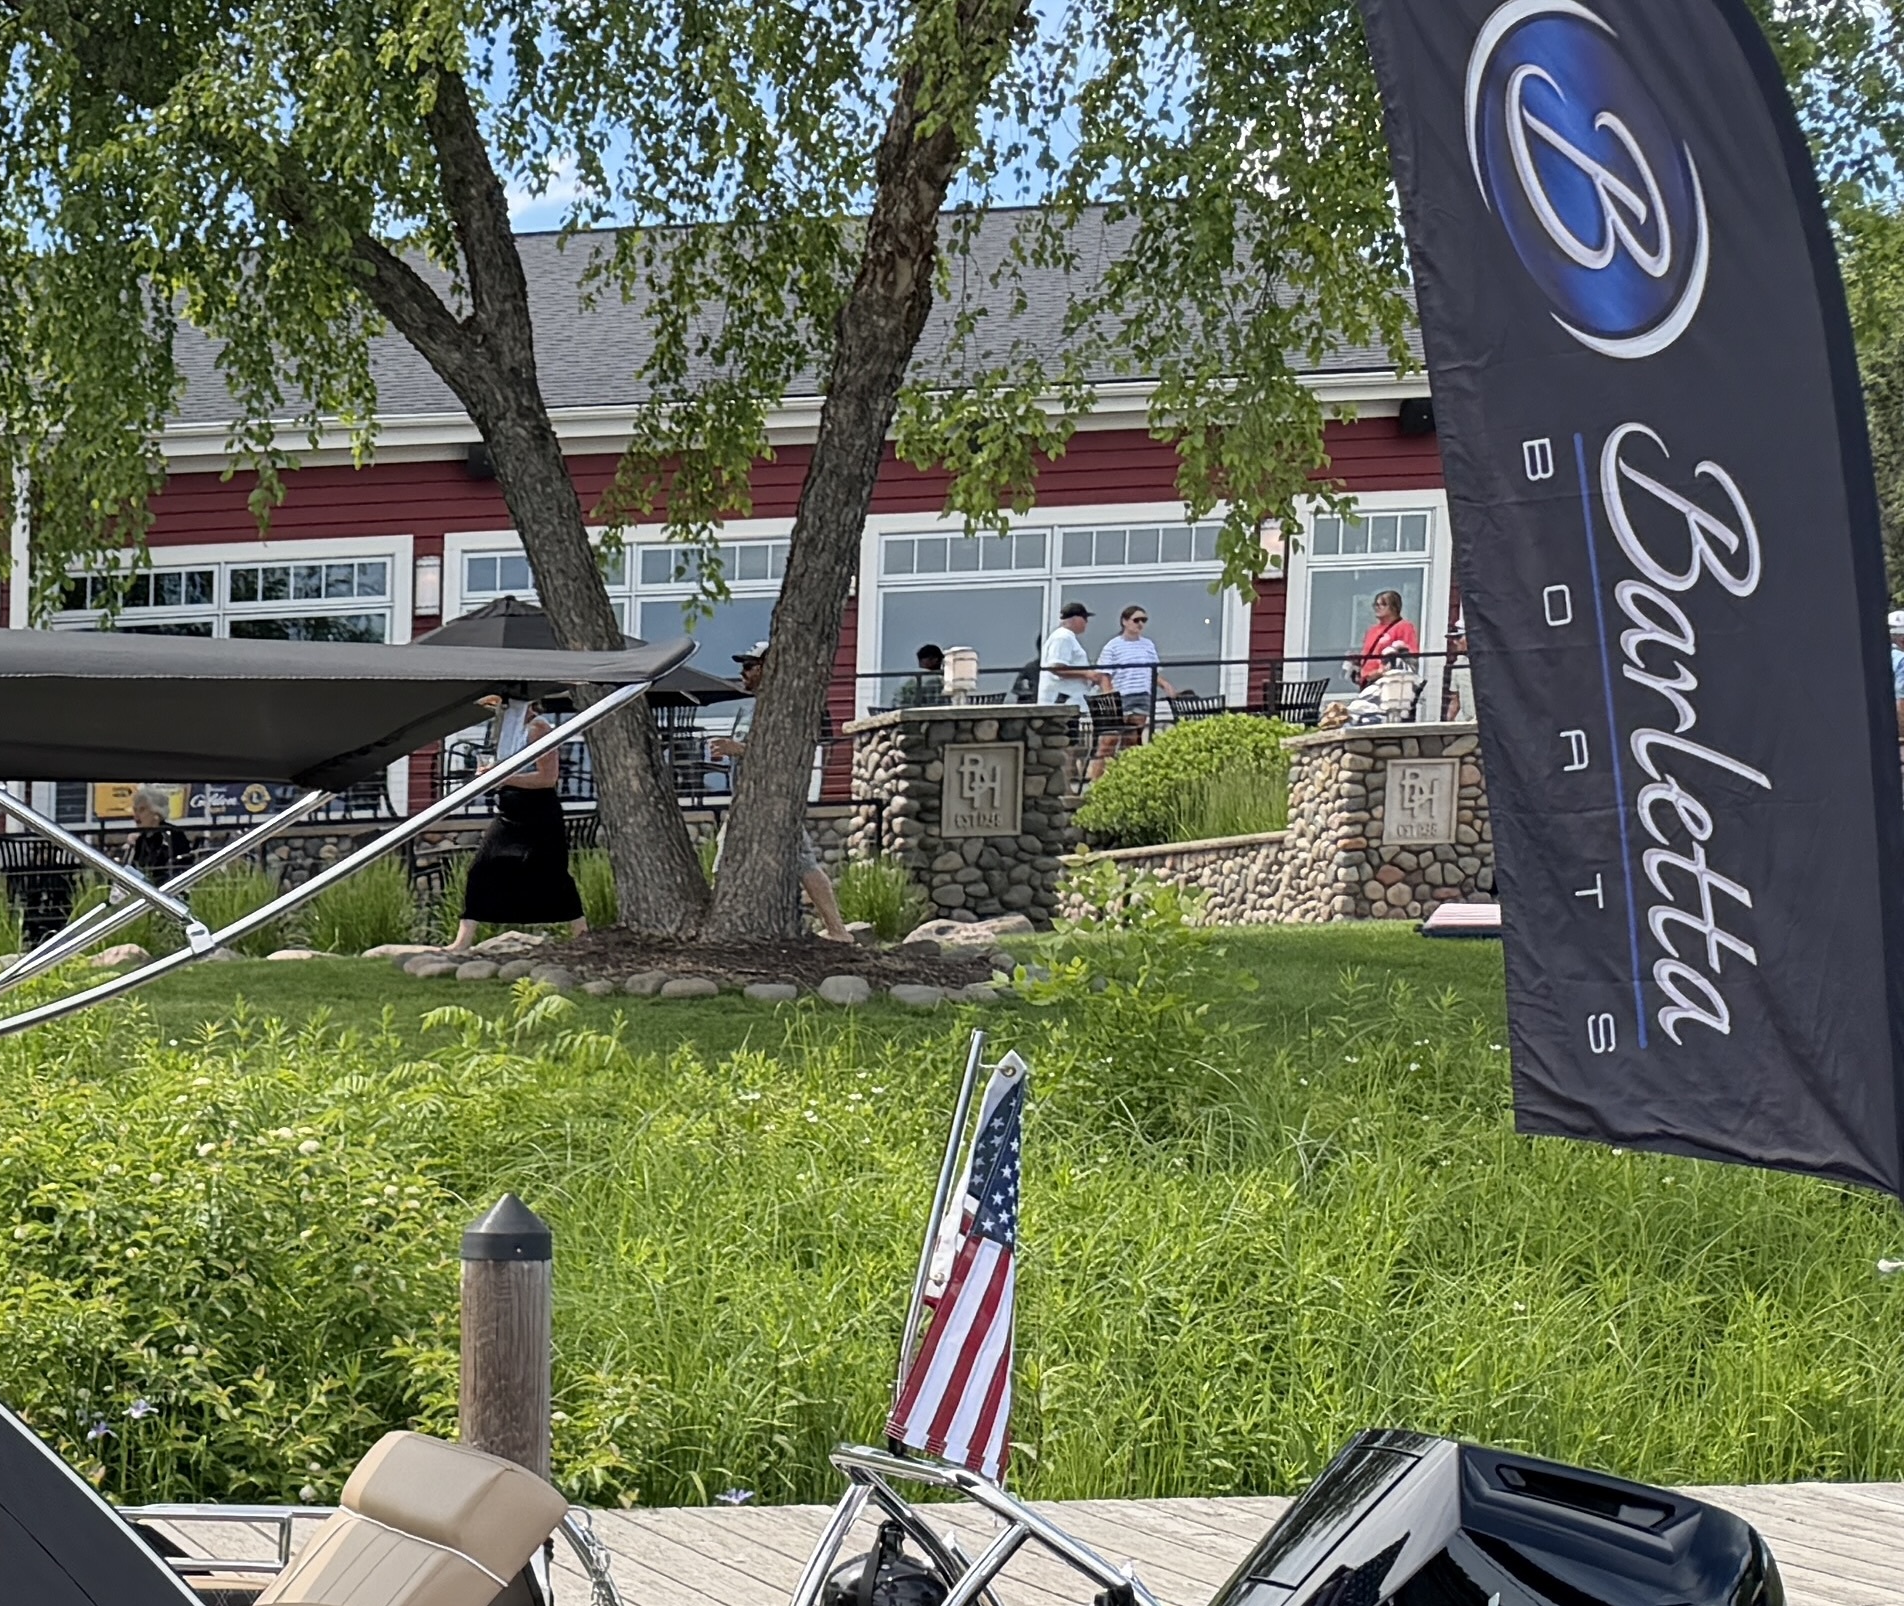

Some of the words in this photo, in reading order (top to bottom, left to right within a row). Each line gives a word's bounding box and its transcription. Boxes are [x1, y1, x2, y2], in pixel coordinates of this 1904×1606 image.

[1504, 63, 1672, 279] B
[1522, 436, 1618, 1055] BOATS
[1600, 421, 1774, 1046] Barletta
